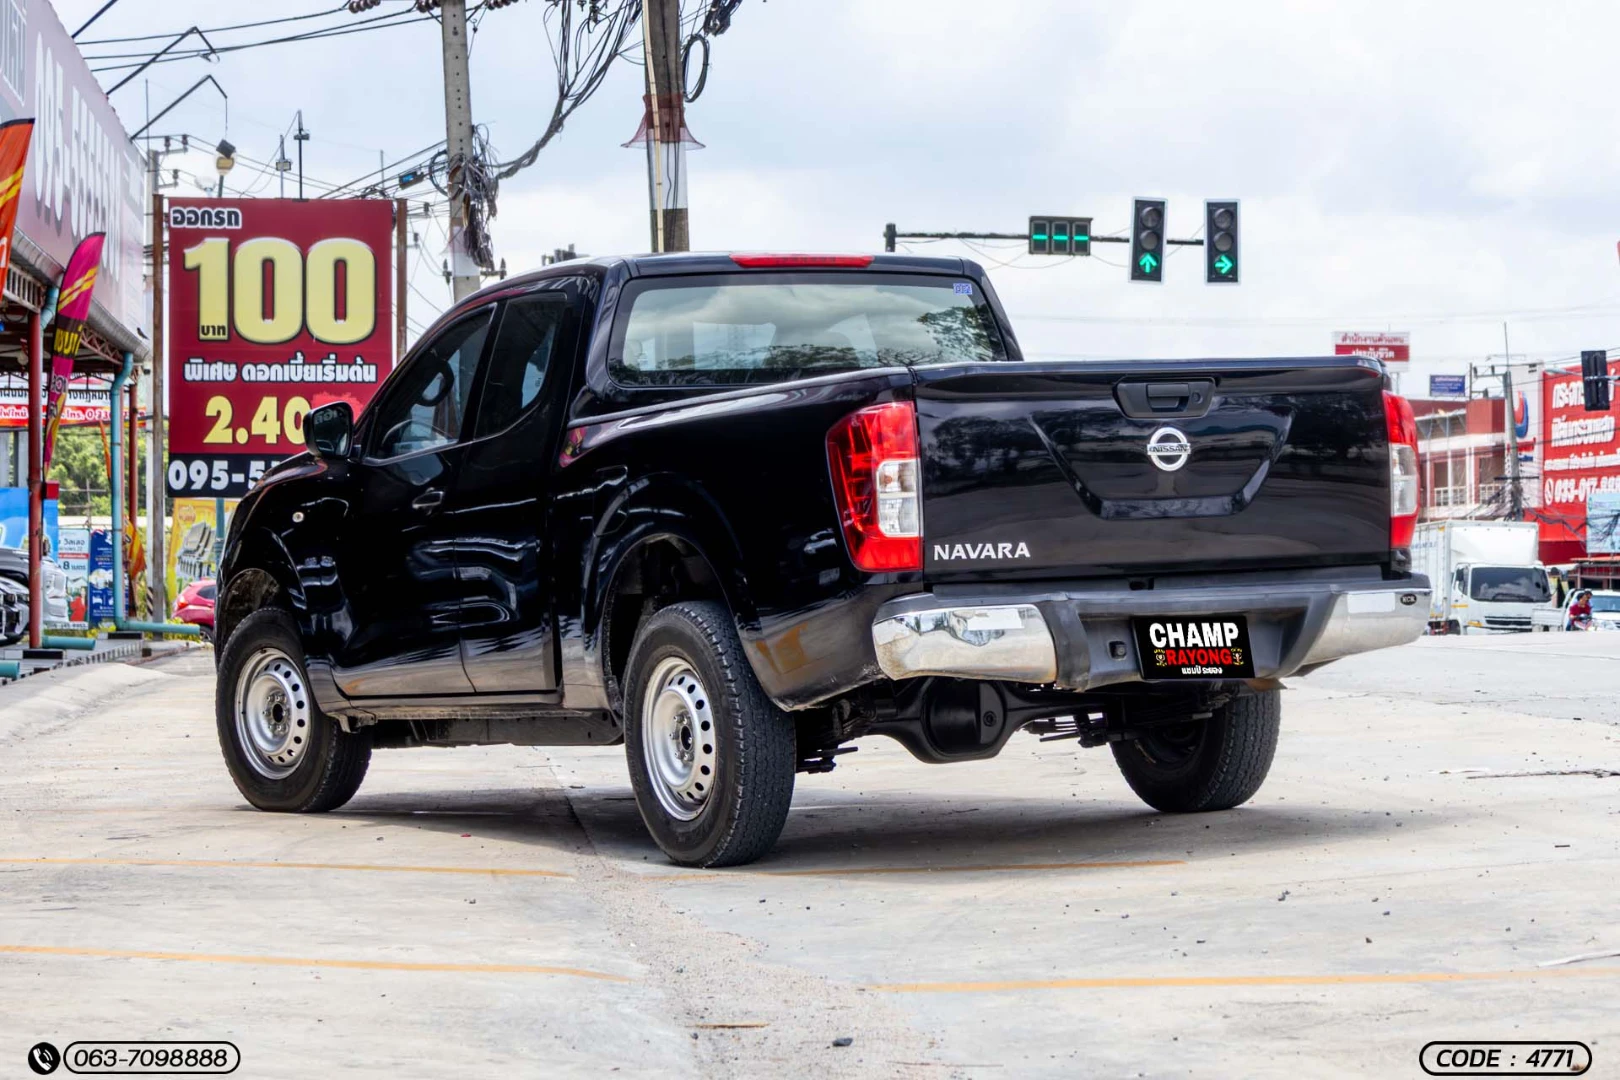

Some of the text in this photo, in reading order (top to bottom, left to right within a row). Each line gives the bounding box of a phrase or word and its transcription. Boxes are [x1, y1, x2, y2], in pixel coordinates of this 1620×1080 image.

[172, 208, 241, 227] ออกรถ
[183, 237, 376, 344] 100
[201, 325, 226, 337] บาท
[184, 350, 378, 383] พิเศษ ดอกเบี้ยเริ่มต้น
[1150, 445, 1187, 453] NISSAN
[168, 459, 280, 491] 095-5
[933, 542, 1031, 561] NAVARA
[1149, 622, 1239, 648] CHAMP
[1165, 648, 1233, 665] RAYONG
